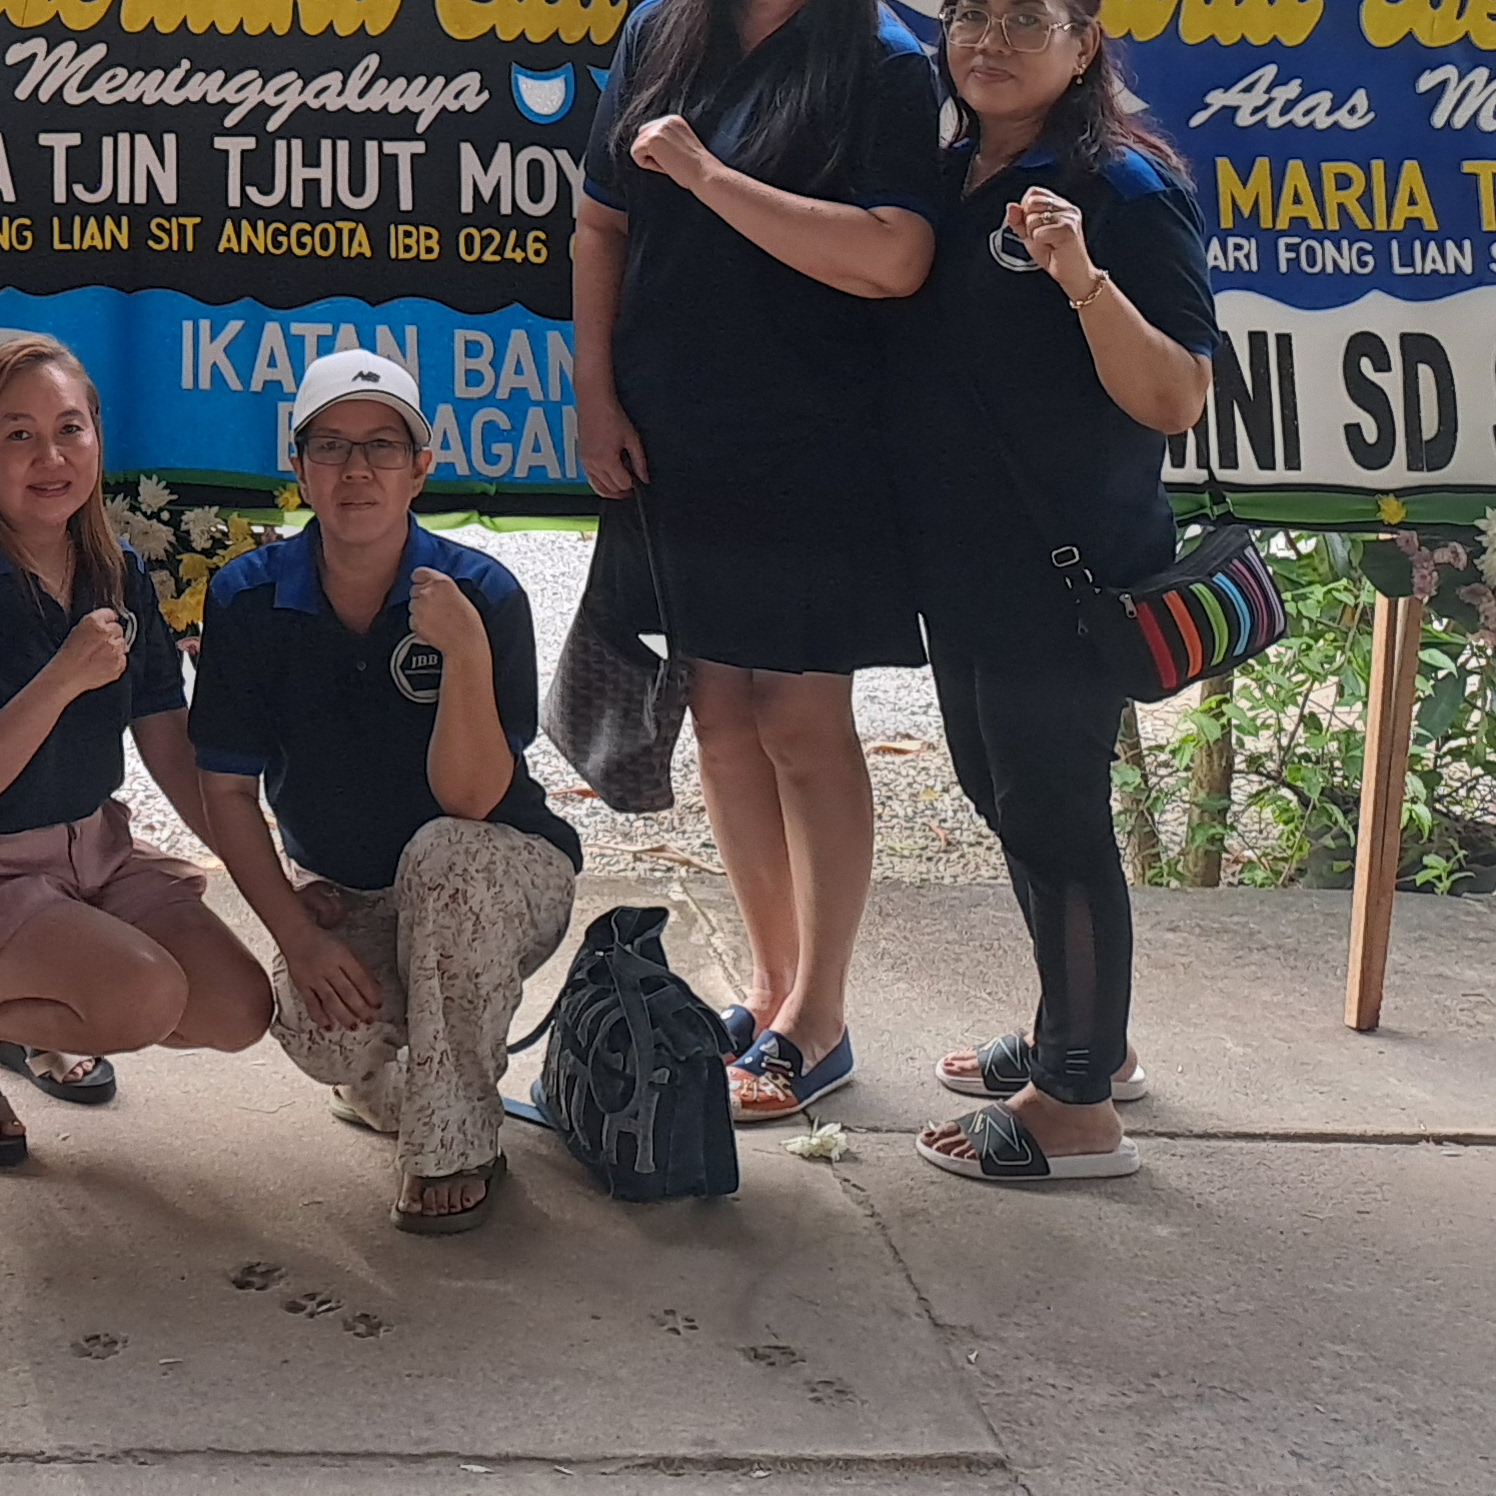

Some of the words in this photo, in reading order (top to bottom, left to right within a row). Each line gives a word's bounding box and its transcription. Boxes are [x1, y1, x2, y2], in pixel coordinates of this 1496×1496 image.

[4, 37, 490, 133] Meninggalnya
[1188, 63, 1375, 130] Atas
[38, 131, 178, 205] TJIN
[214, 134, 426, 212] TJHUT
[459, 142, 587, 218] MOY
[1214, 156, 1438, 232] MARIA
[52, 216, 129, 252] LIAN
[147, 216, 201, 253] SIT
[217, 218, 372, 260] ANGGOTA
[389, 224, 440, 260] IBB
[458, 227, 548, 264] 0246
[1277, 237, 1375, 274] FONG
[1391, 238, 1473, 274] LIAN
[1342, 330, 1459, 472] SD
